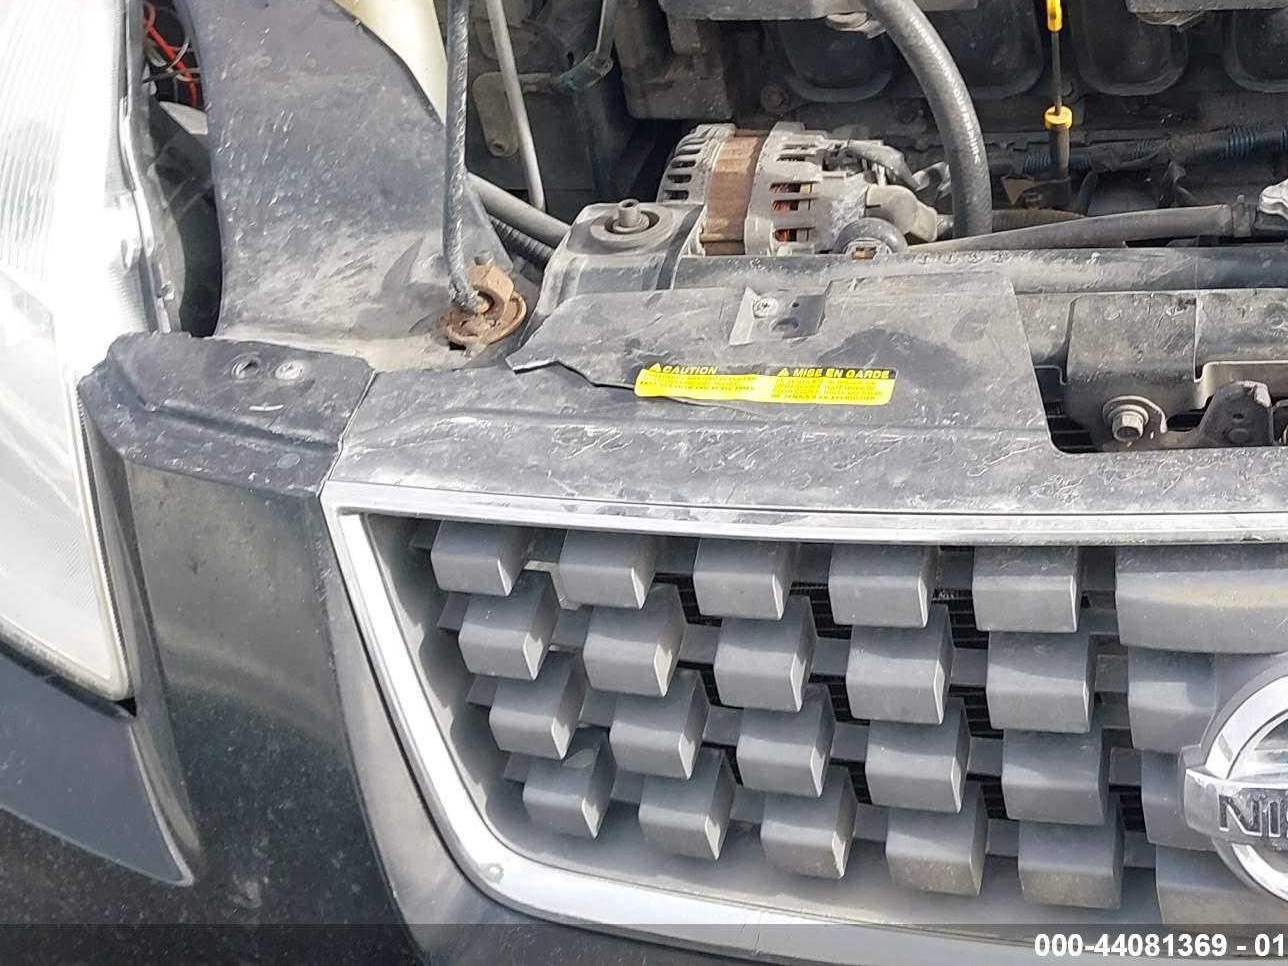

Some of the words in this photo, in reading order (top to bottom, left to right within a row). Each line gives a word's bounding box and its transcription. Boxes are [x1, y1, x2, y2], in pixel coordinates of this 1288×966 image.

[662, 364, 718, 375] CAUTION
[792, 367, 823, 378] MISE
[825, 367, 844, 378] EN
[845, 369, 890, 379] GARDE
